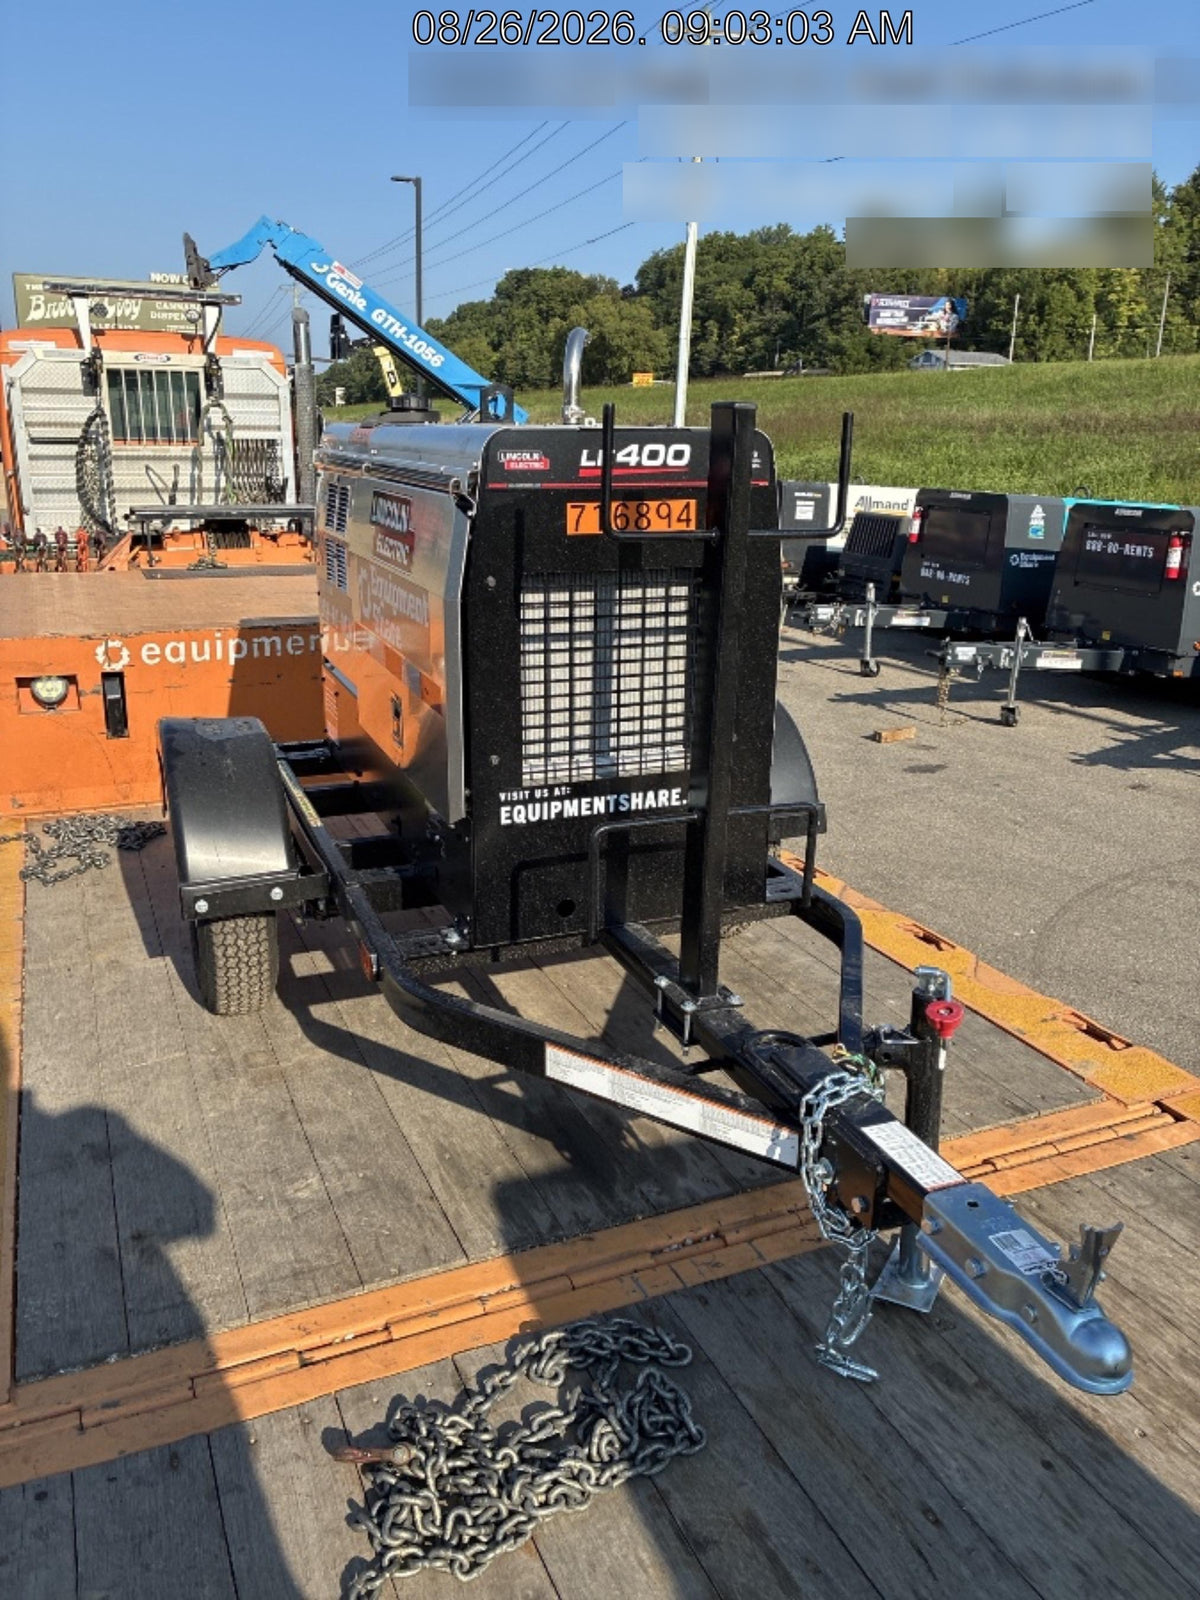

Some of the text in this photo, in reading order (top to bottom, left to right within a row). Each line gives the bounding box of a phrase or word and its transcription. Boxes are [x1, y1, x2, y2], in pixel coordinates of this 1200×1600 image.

[150, 272, 181, 284] NOW
[326, 272, 446, 368] Genie GTH-1056
[501, 452, 540, 461] LINCOLN
[855, 495, 909, 512] Allmand
[499, 787, 571, 802] VISIT US AT:
